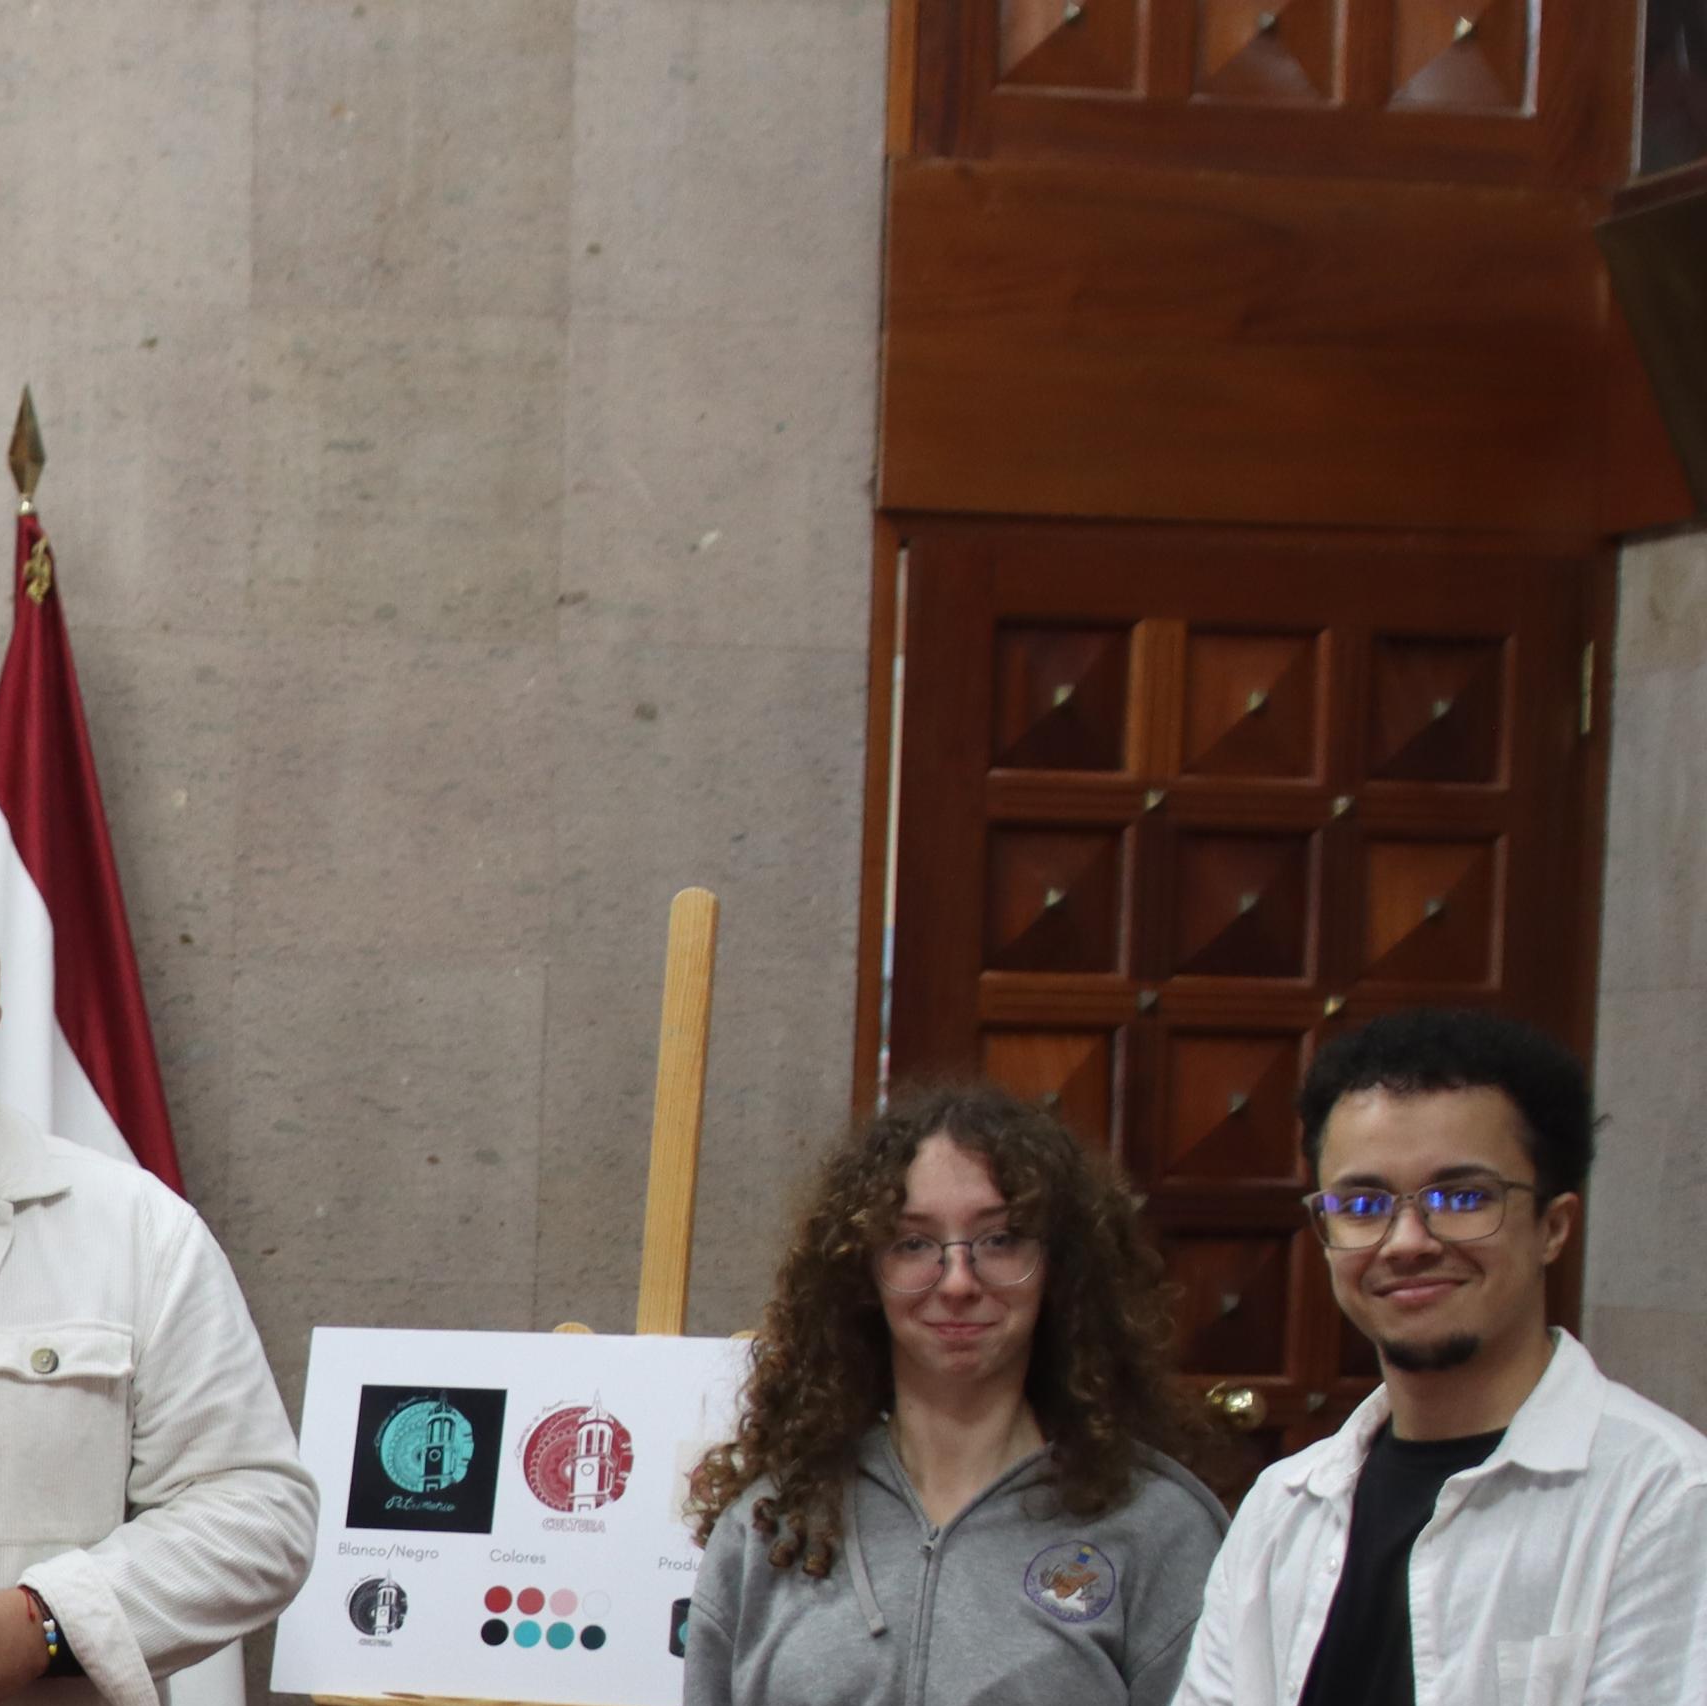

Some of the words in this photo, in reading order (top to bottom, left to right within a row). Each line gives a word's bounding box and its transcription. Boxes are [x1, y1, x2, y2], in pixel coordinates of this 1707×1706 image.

[542, 1518, 606, 1533] CULTURA
[338, 1541, 440, 1562] Blanco/Negro
[489, 1548, 547, 1565] Colores
